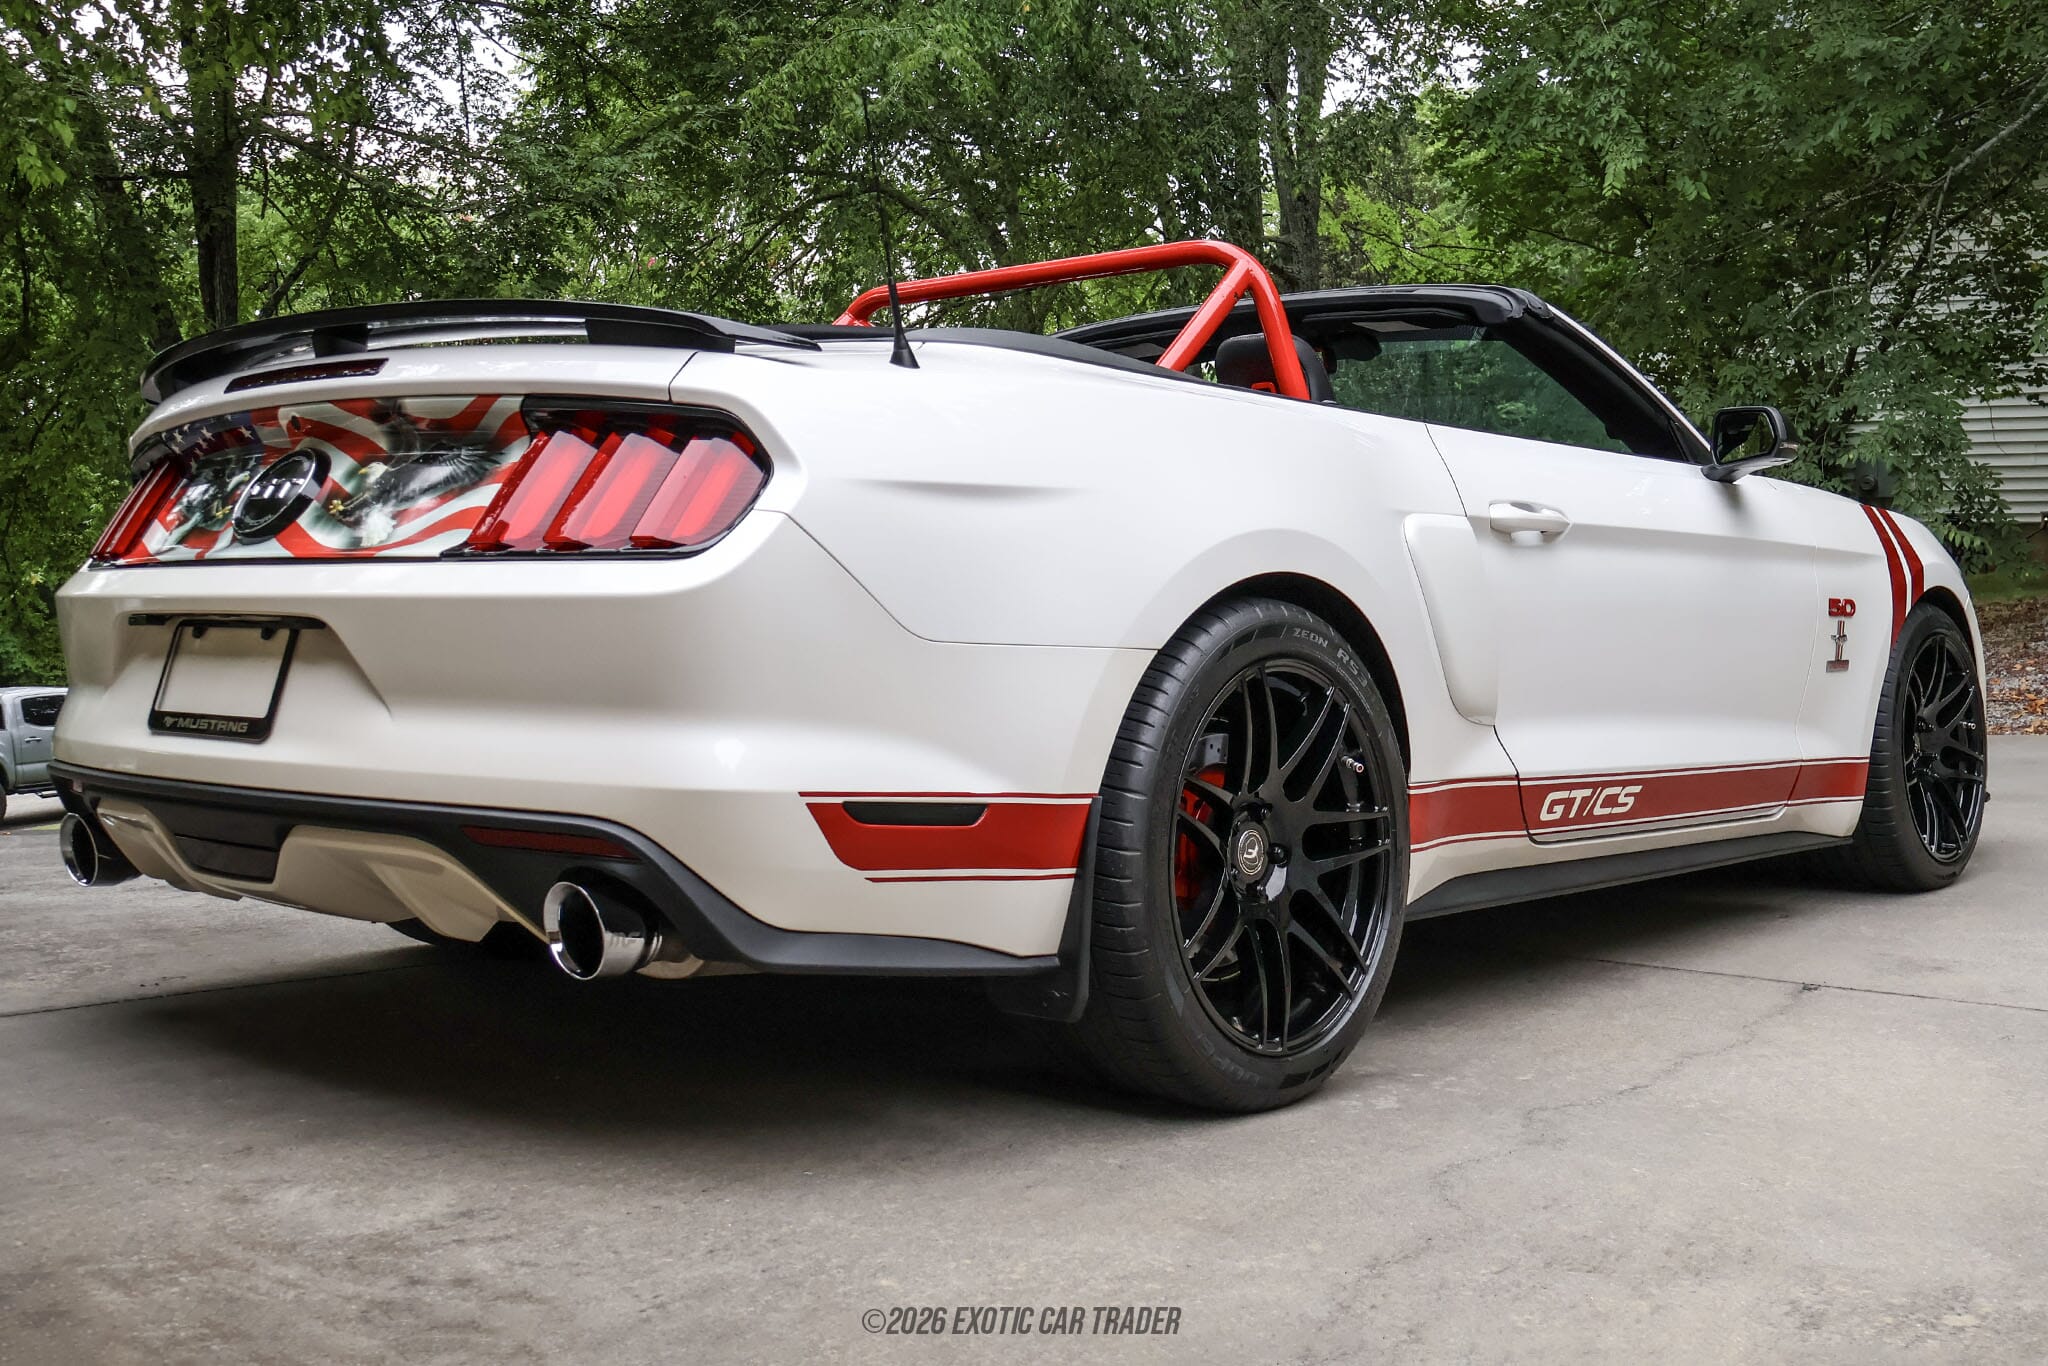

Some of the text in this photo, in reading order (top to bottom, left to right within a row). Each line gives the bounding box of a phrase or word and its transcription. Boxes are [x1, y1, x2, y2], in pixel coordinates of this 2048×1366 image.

[1293, 627, 1368, 687] ZEON RS3
[176, 717, 248, 733] MUSTANG
[1540, 785, 1643, 821] GT/CS
